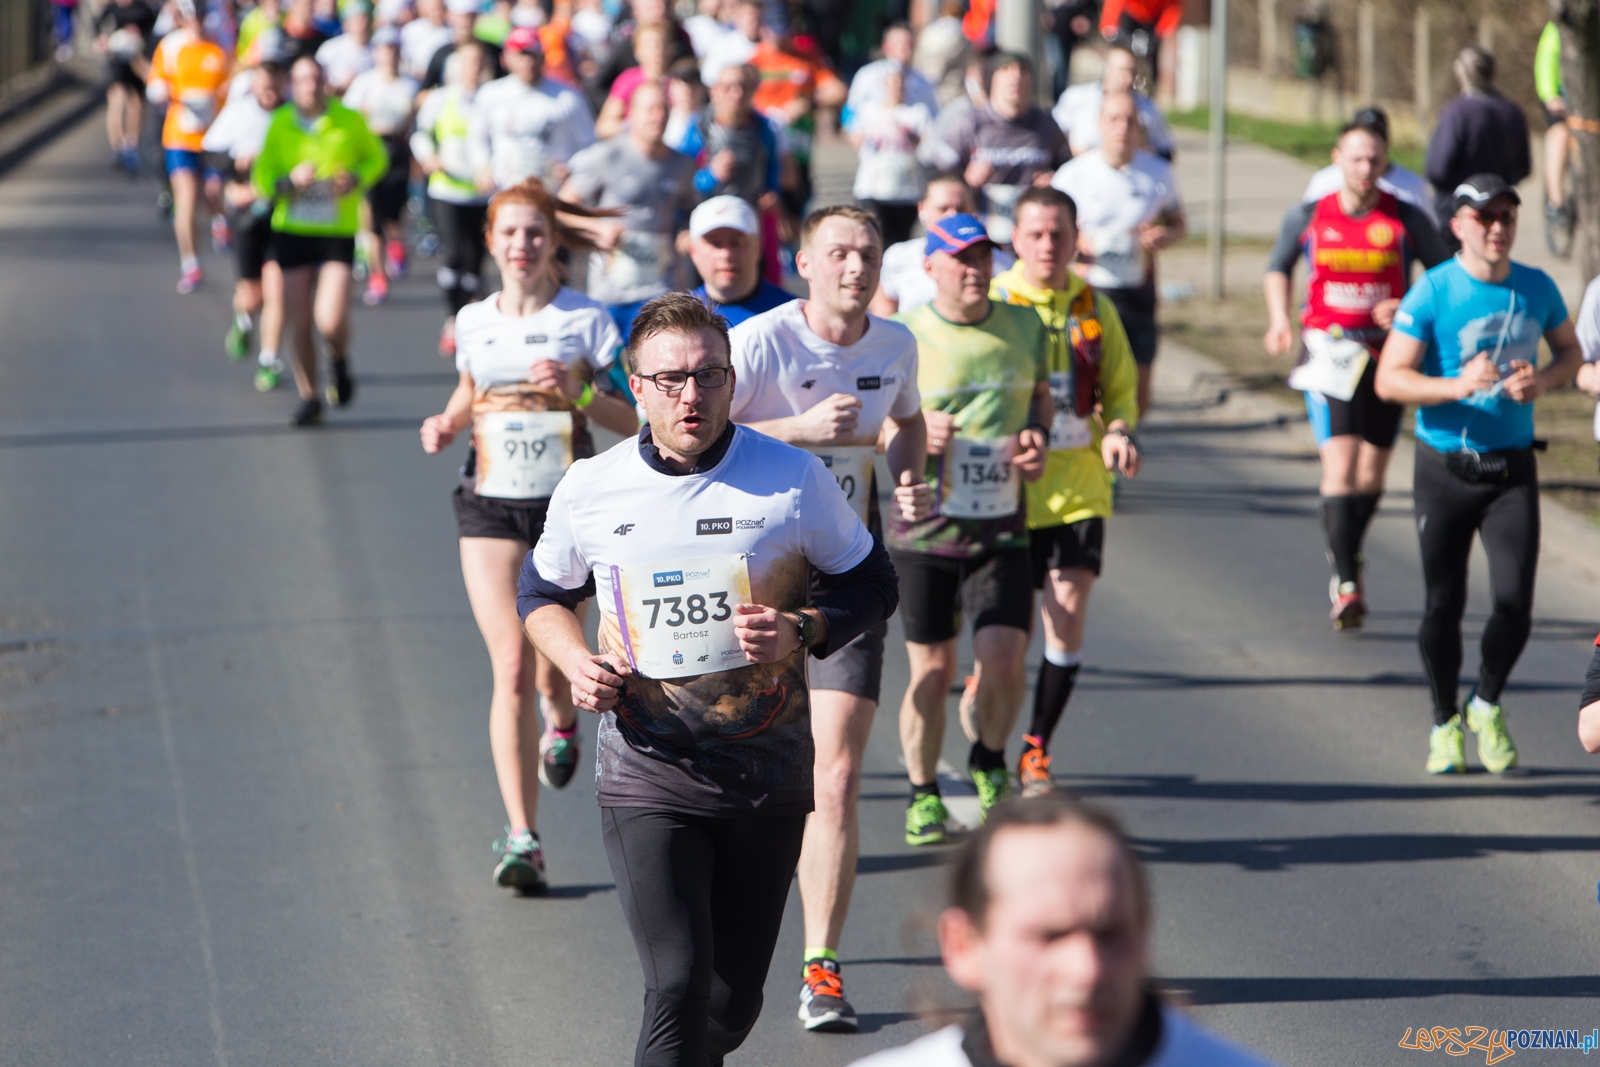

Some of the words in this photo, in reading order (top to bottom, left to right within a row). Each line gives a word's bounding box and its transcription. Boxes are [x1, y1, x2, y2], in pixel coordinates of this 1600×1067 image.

[504, 438, 547, 461] 919
[959, 462, 1010, 485] 1343
[613, 523, 636, 536] 4F
[700, 523, 711, 531] 10.
[712, 521, 730, 531] PKO
[656, 576, 666, 584] 10.
[666, 574, 682, 583] PKO
[642, 591, 732, 628] 7383
[673, 629, 709, 641] Bartosz
[697, 654, 710, 662] 4F
